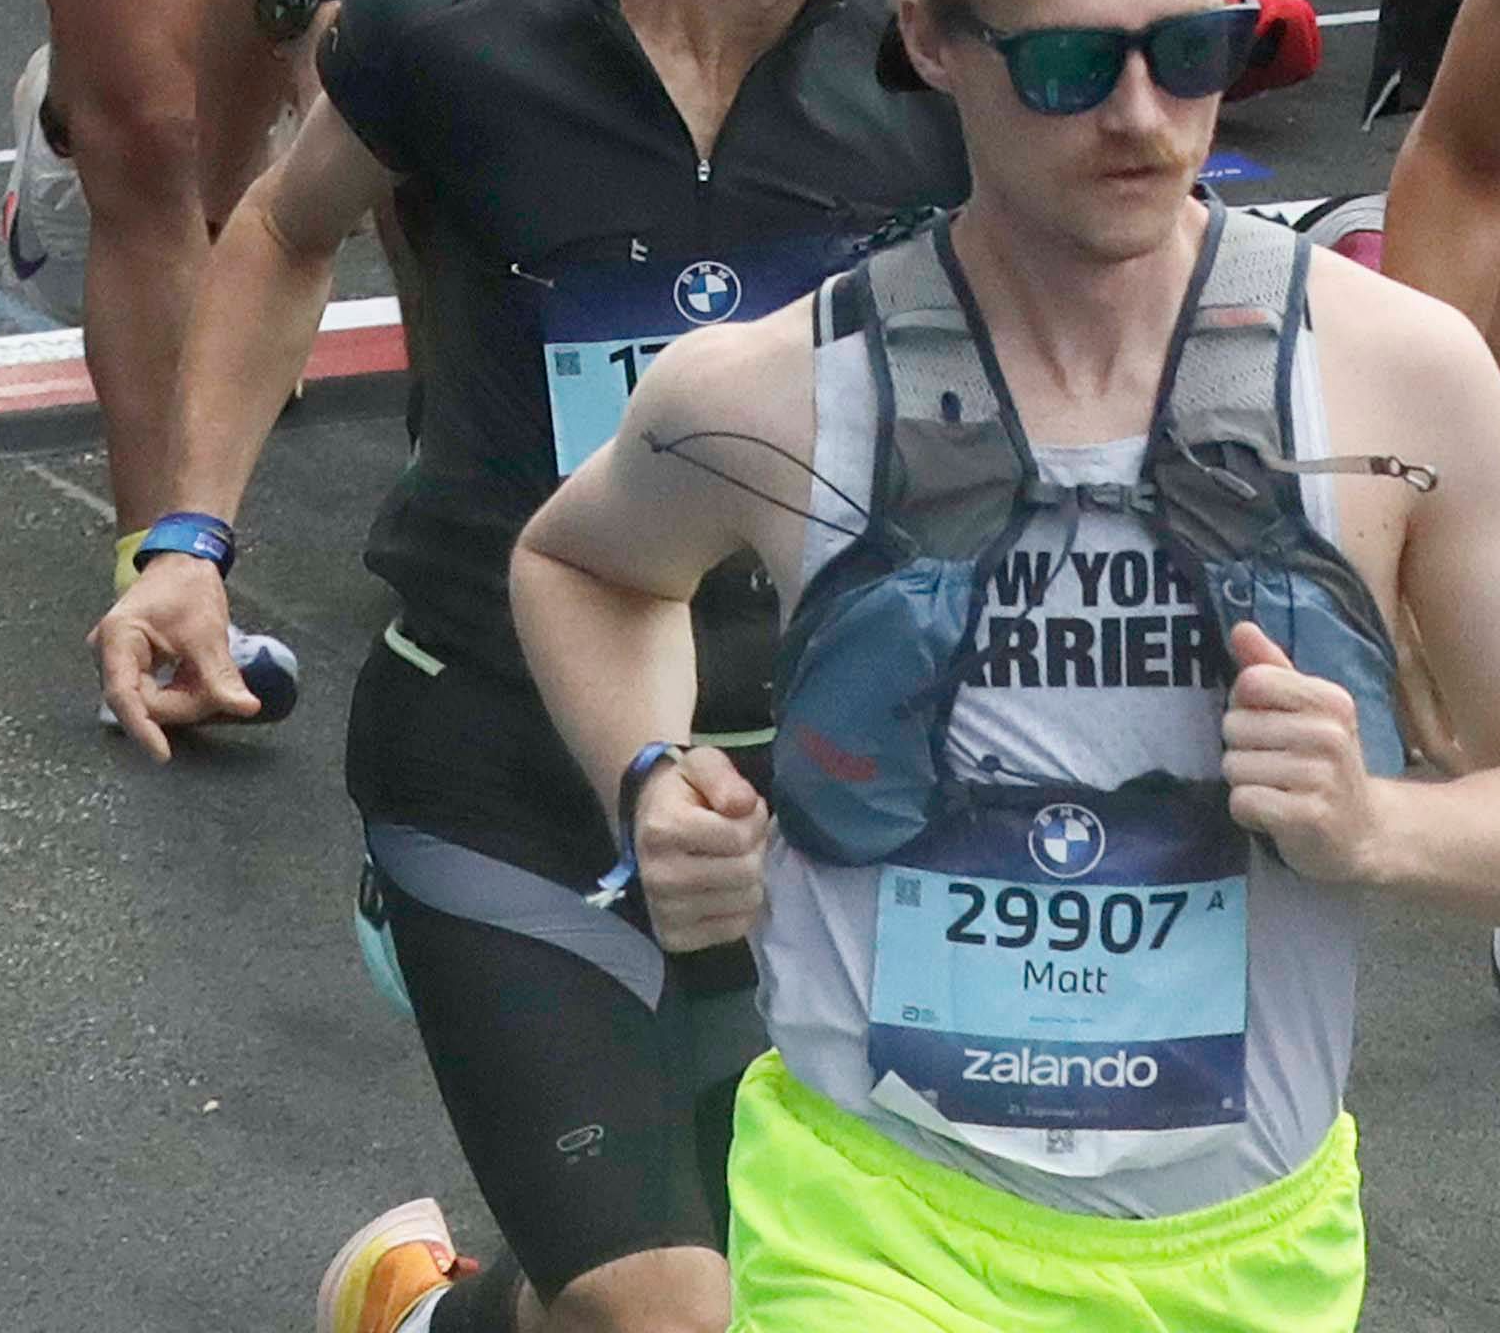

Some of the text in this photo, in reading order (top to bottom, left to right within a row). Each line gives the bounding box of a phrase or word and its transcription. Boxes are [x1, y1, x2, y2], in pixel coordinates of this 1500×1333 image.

[943, 882, 1190, 955] 29907
[1204, 889, 1228, 913] A
[1021, 958, 1110, 997] Matt
[960, 1044, 1160, 1090] zalando
